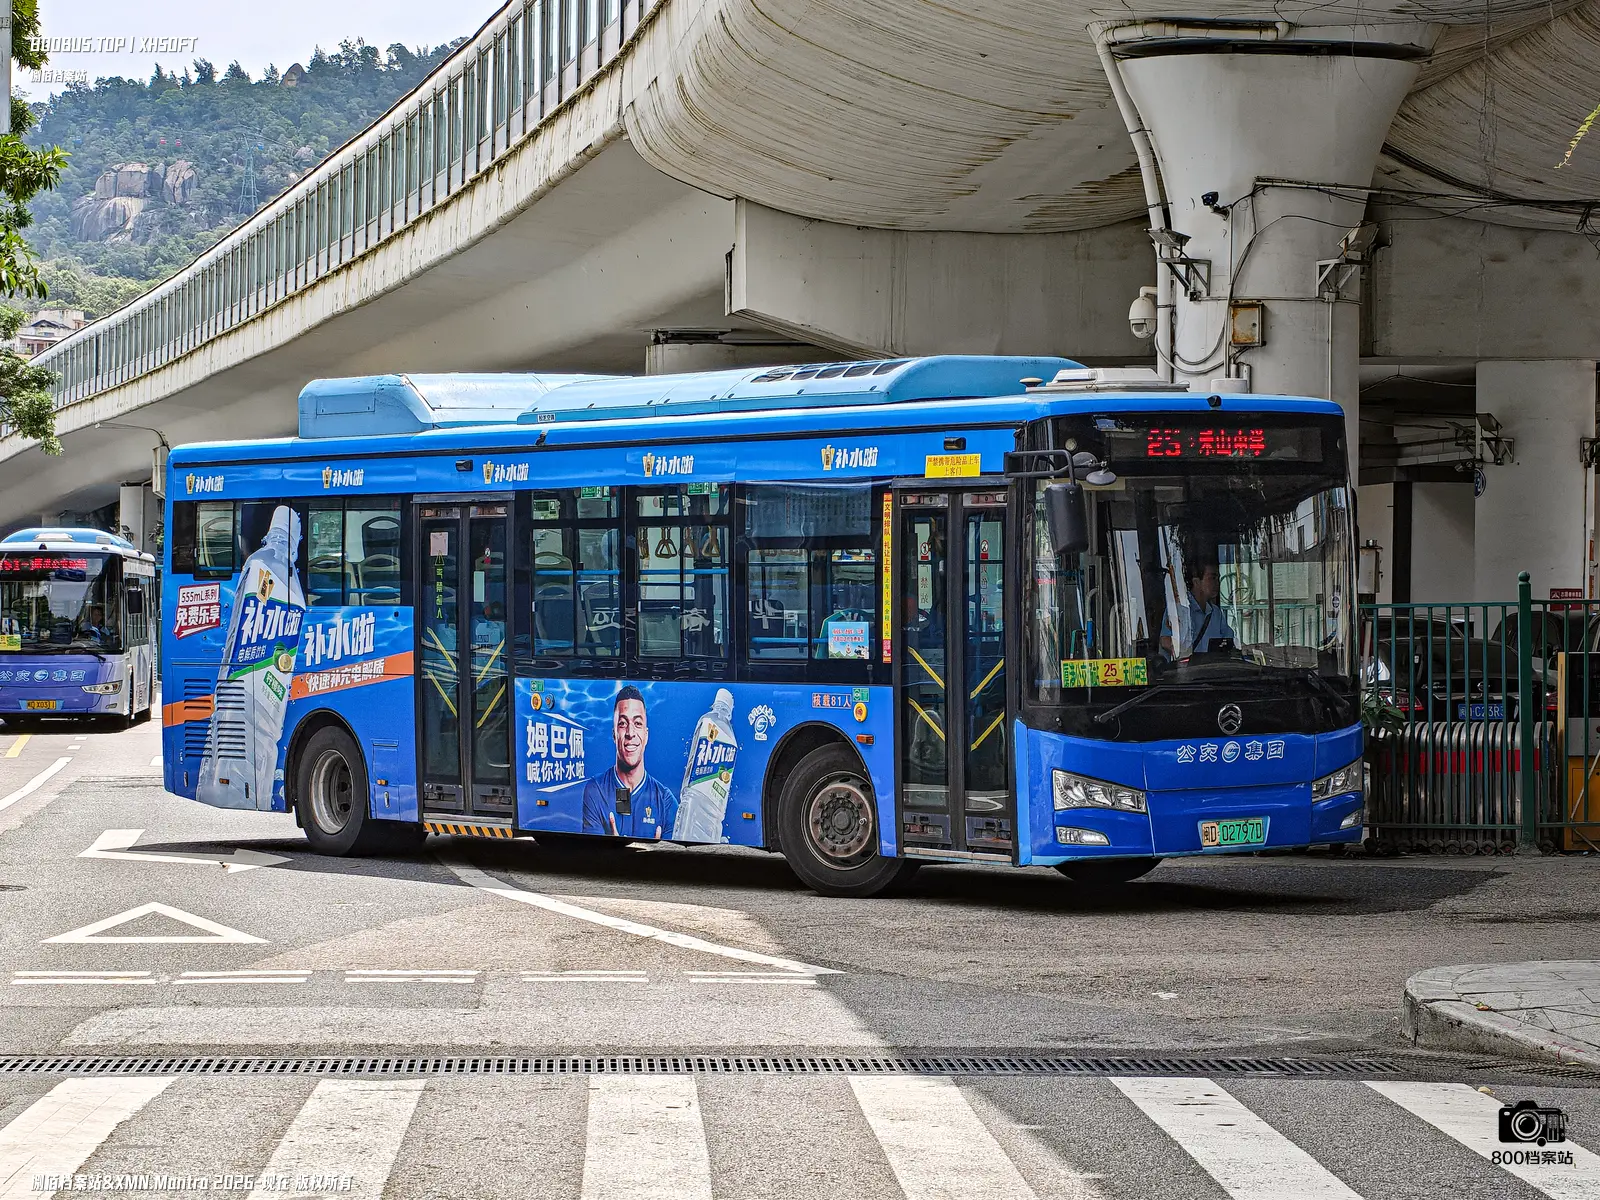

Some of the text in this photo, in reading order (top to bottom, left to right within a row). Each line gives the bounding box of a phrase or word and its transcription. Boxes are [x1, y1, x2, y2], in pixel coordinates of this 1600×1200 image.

[655, 455, 695, 476] 补水啦
[835, 446, 879, 469] 补水啦
[332, 468, 365, 488] 补水啦
[494, 462, 530, 483] 补水啦
[943, 466, 963, 477] 上客门
[195, 475, 225, 493] 补水啦
[181, 588, 218, 603] 555mL系列
[174, 604, 221, 633] 免费乐享
[241, 600, 302, 645] 补水啦
[304, 611, 376, 667] 补水啦
[237, 645, 267, 662] 电解质饮料
[307, 658, 385, 693] 快速补充电解质
[1103, 663, 1118, 677] 25
[813, 693, 852, 708] 核载81人
[526, 719, 585, 759] 姆巴佩
[697, 740, 737, 766] 补水啦
[1176, 740, 1285, 764] 公交 集团
[526, 760, 586, 784] 喊你补水啦
